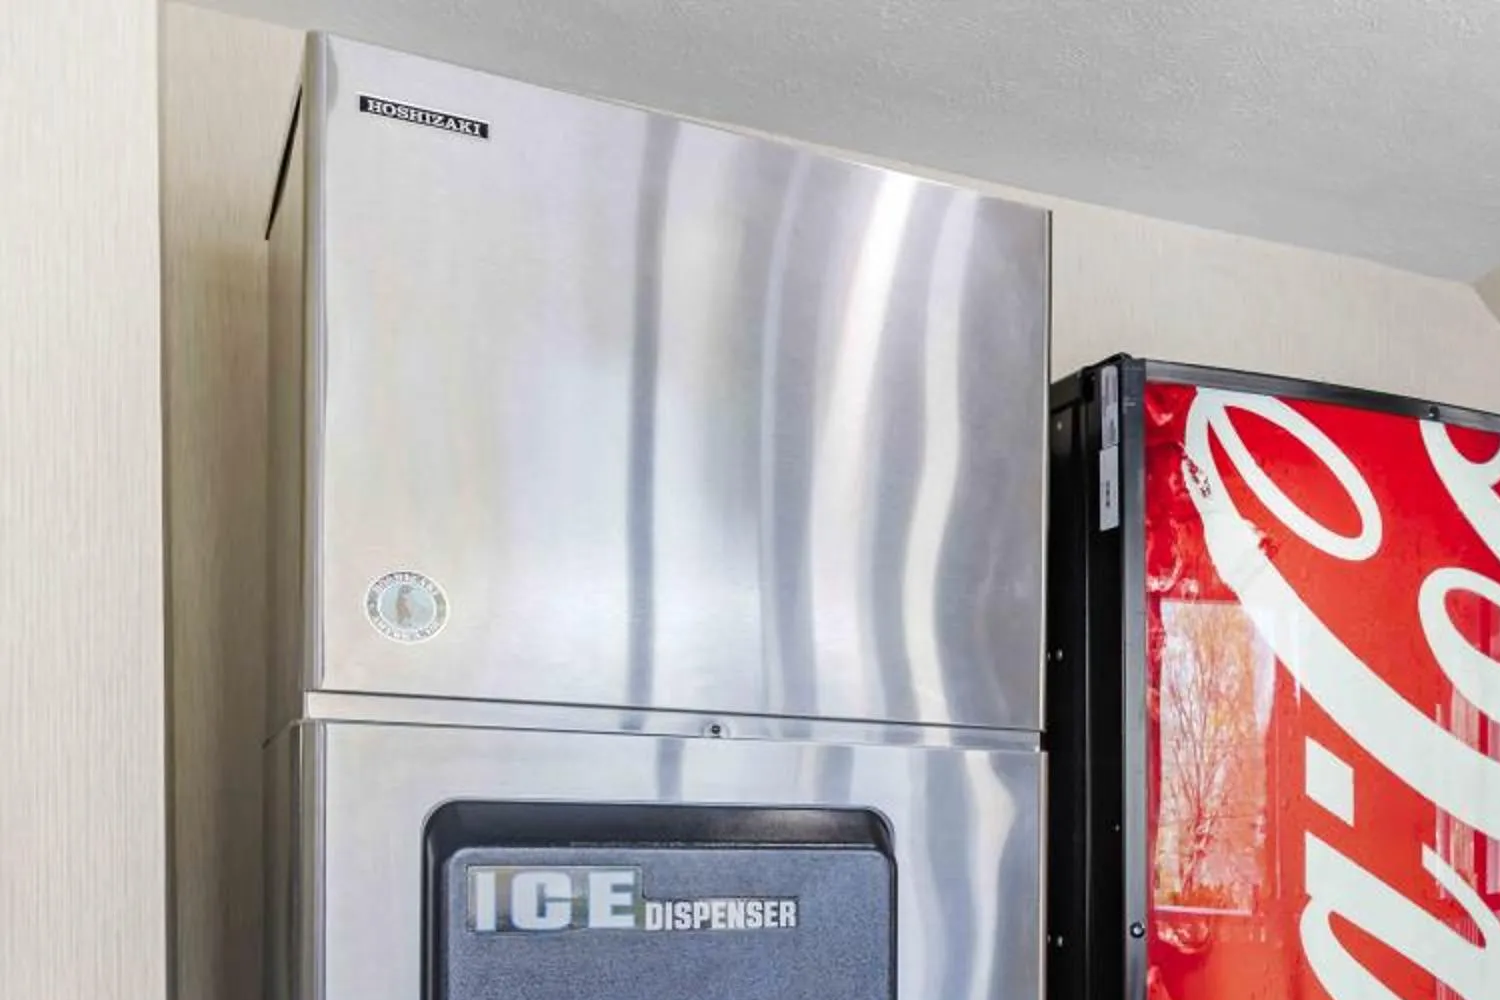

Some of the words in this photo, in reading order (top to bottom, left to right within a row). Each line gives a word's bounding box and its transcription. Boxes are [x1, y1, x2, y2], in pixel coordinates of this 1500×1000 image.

[367, 97, 482, 137] HOSHIZAKI
[473, 870, 636, 932] ICE
[645, 898, 798, 931] DISPENSER
